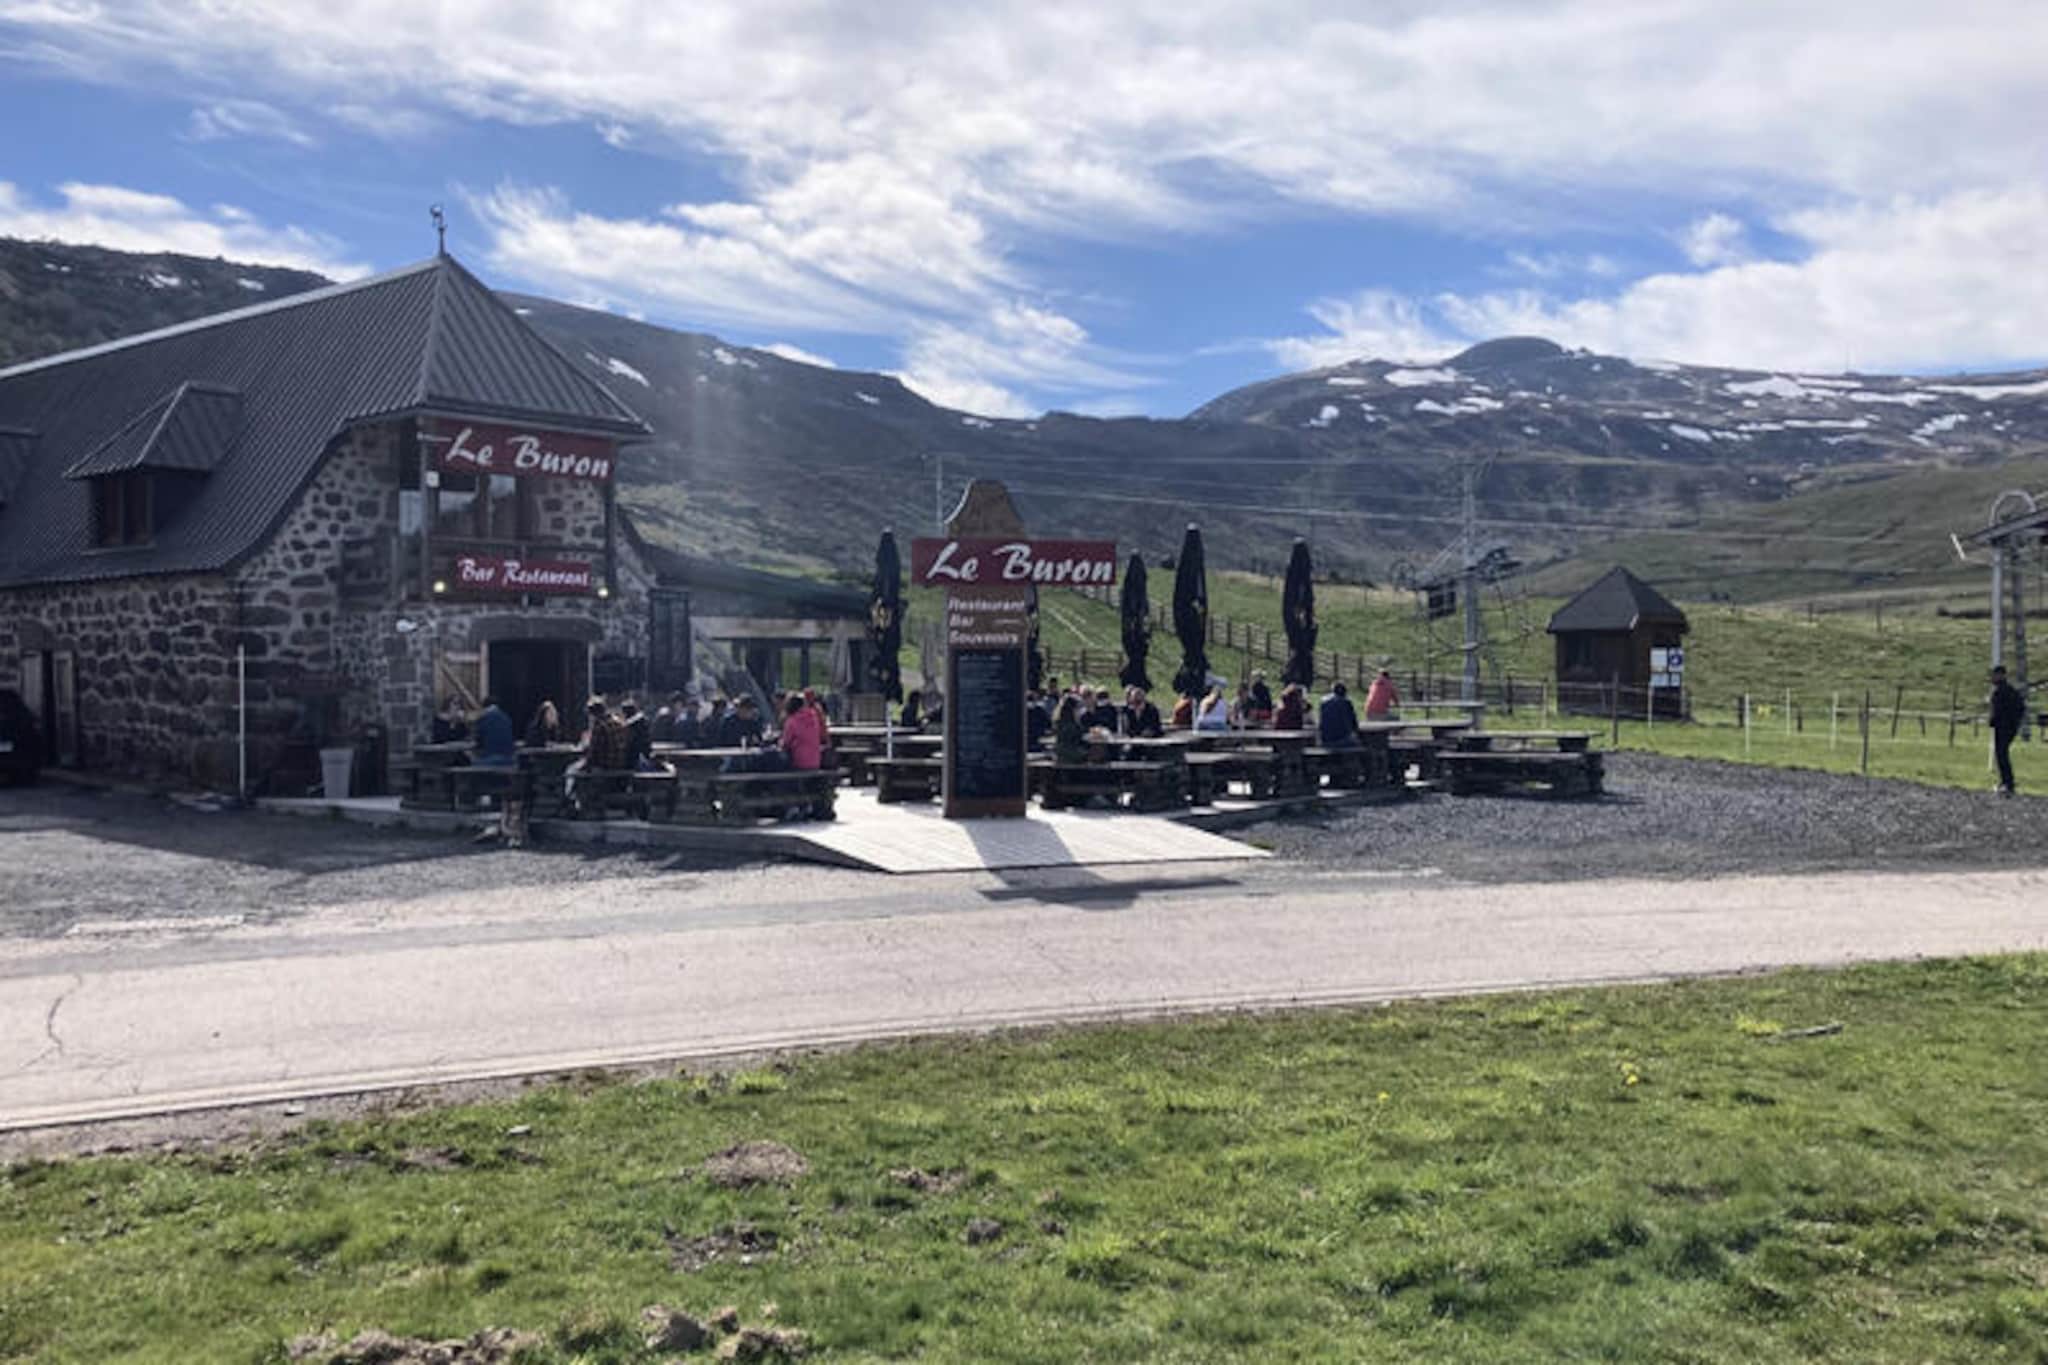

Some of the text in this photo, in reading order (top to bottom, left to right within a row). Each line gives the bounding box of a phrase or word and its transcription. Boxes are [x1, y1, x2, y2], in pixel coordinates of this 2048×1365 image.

[446, 428, 609, 478] Le Buron
[457, 558, 589, 587] Bar Restaurant
[925, 541, 1113, 582] Le Buron
[949, 598, 1025, 612] Restaurant
[950, 613, 975, 627] Bar
[949, 630, 1019, 646] Souvenirs
